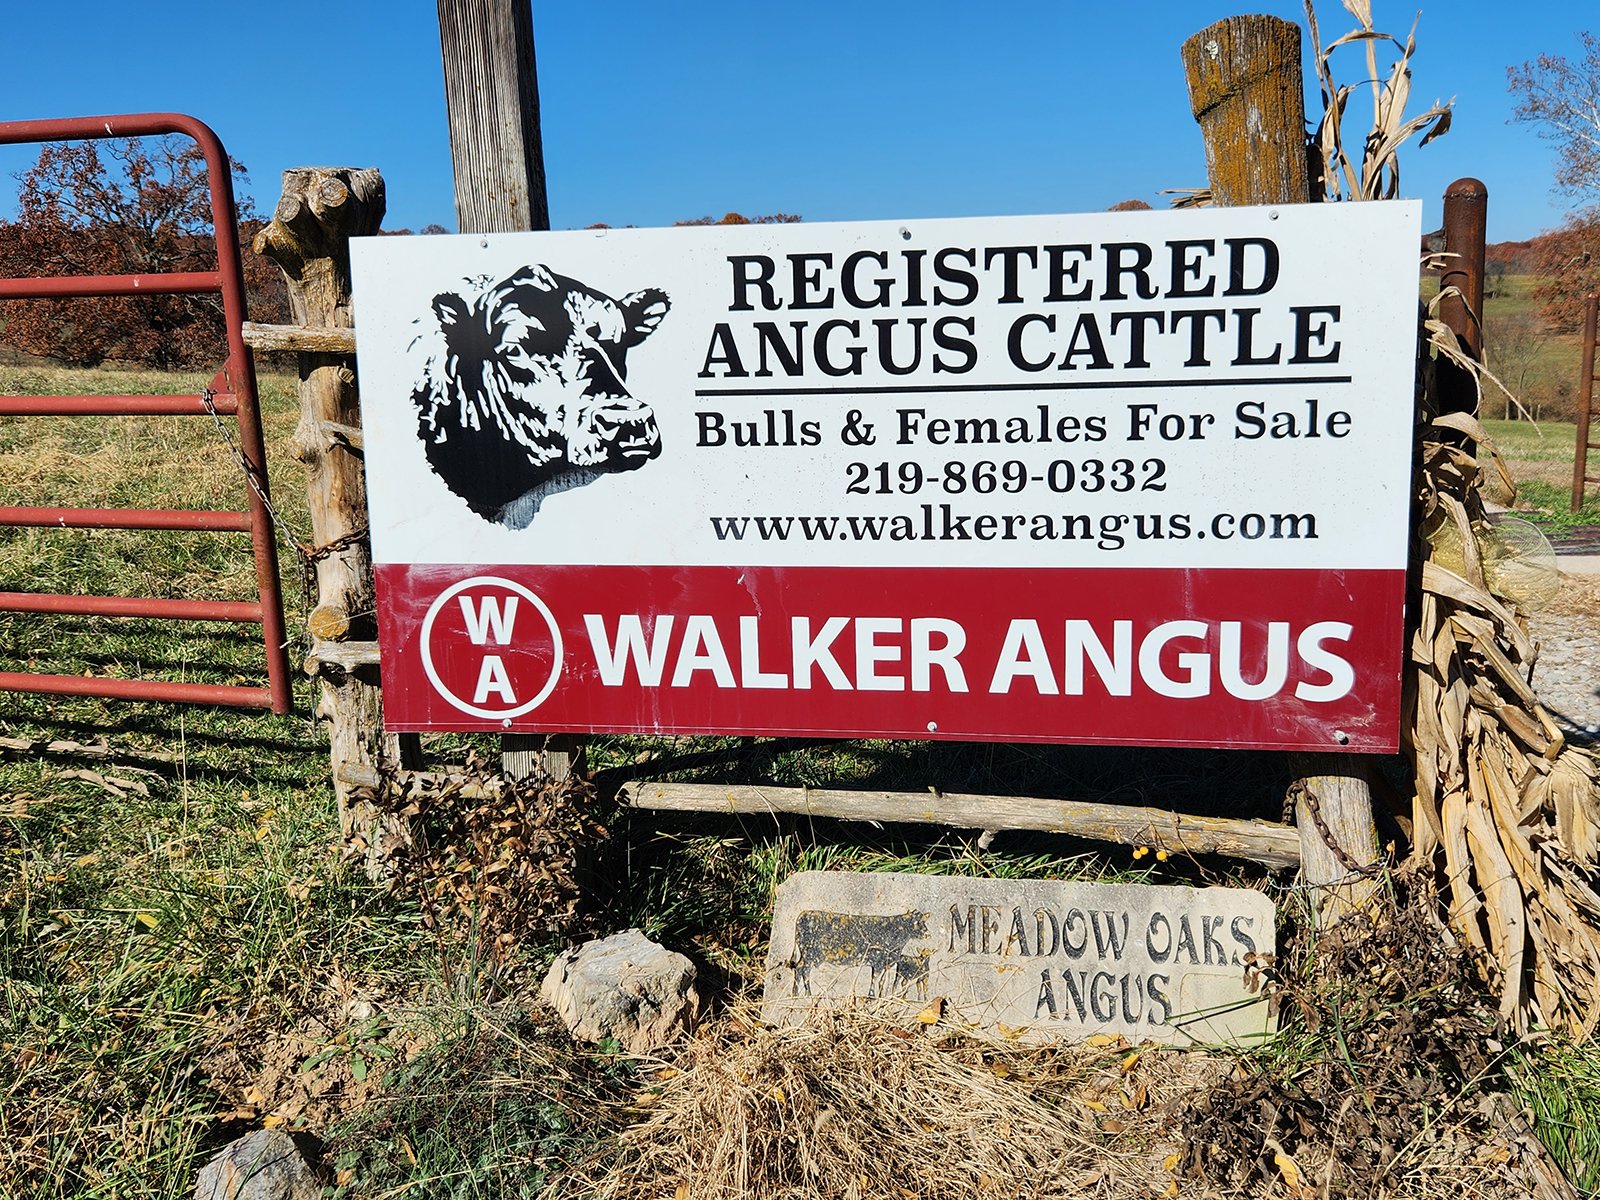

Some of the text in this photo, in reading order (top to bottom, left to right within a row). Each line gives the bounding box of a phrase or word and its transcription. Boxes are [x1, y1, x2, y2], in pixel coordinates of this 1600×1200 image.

[727, 237, 1280, 312] REGISTERED
[698, 305, 1342, 378] ANGUS CATTLE
[696, 400, 1352, 447] Bulls & Females For Sale
[846, 458, 1167, 496] 219-869-0332
[711, 505, 1319, 550] www.walkerangus.com
[584, 614, 1355, 703] WALKER ANGUS
[949, 902, 1258, 967] MEADOW OAKS
[1034, 968, 1173, 1026] ANGUS
